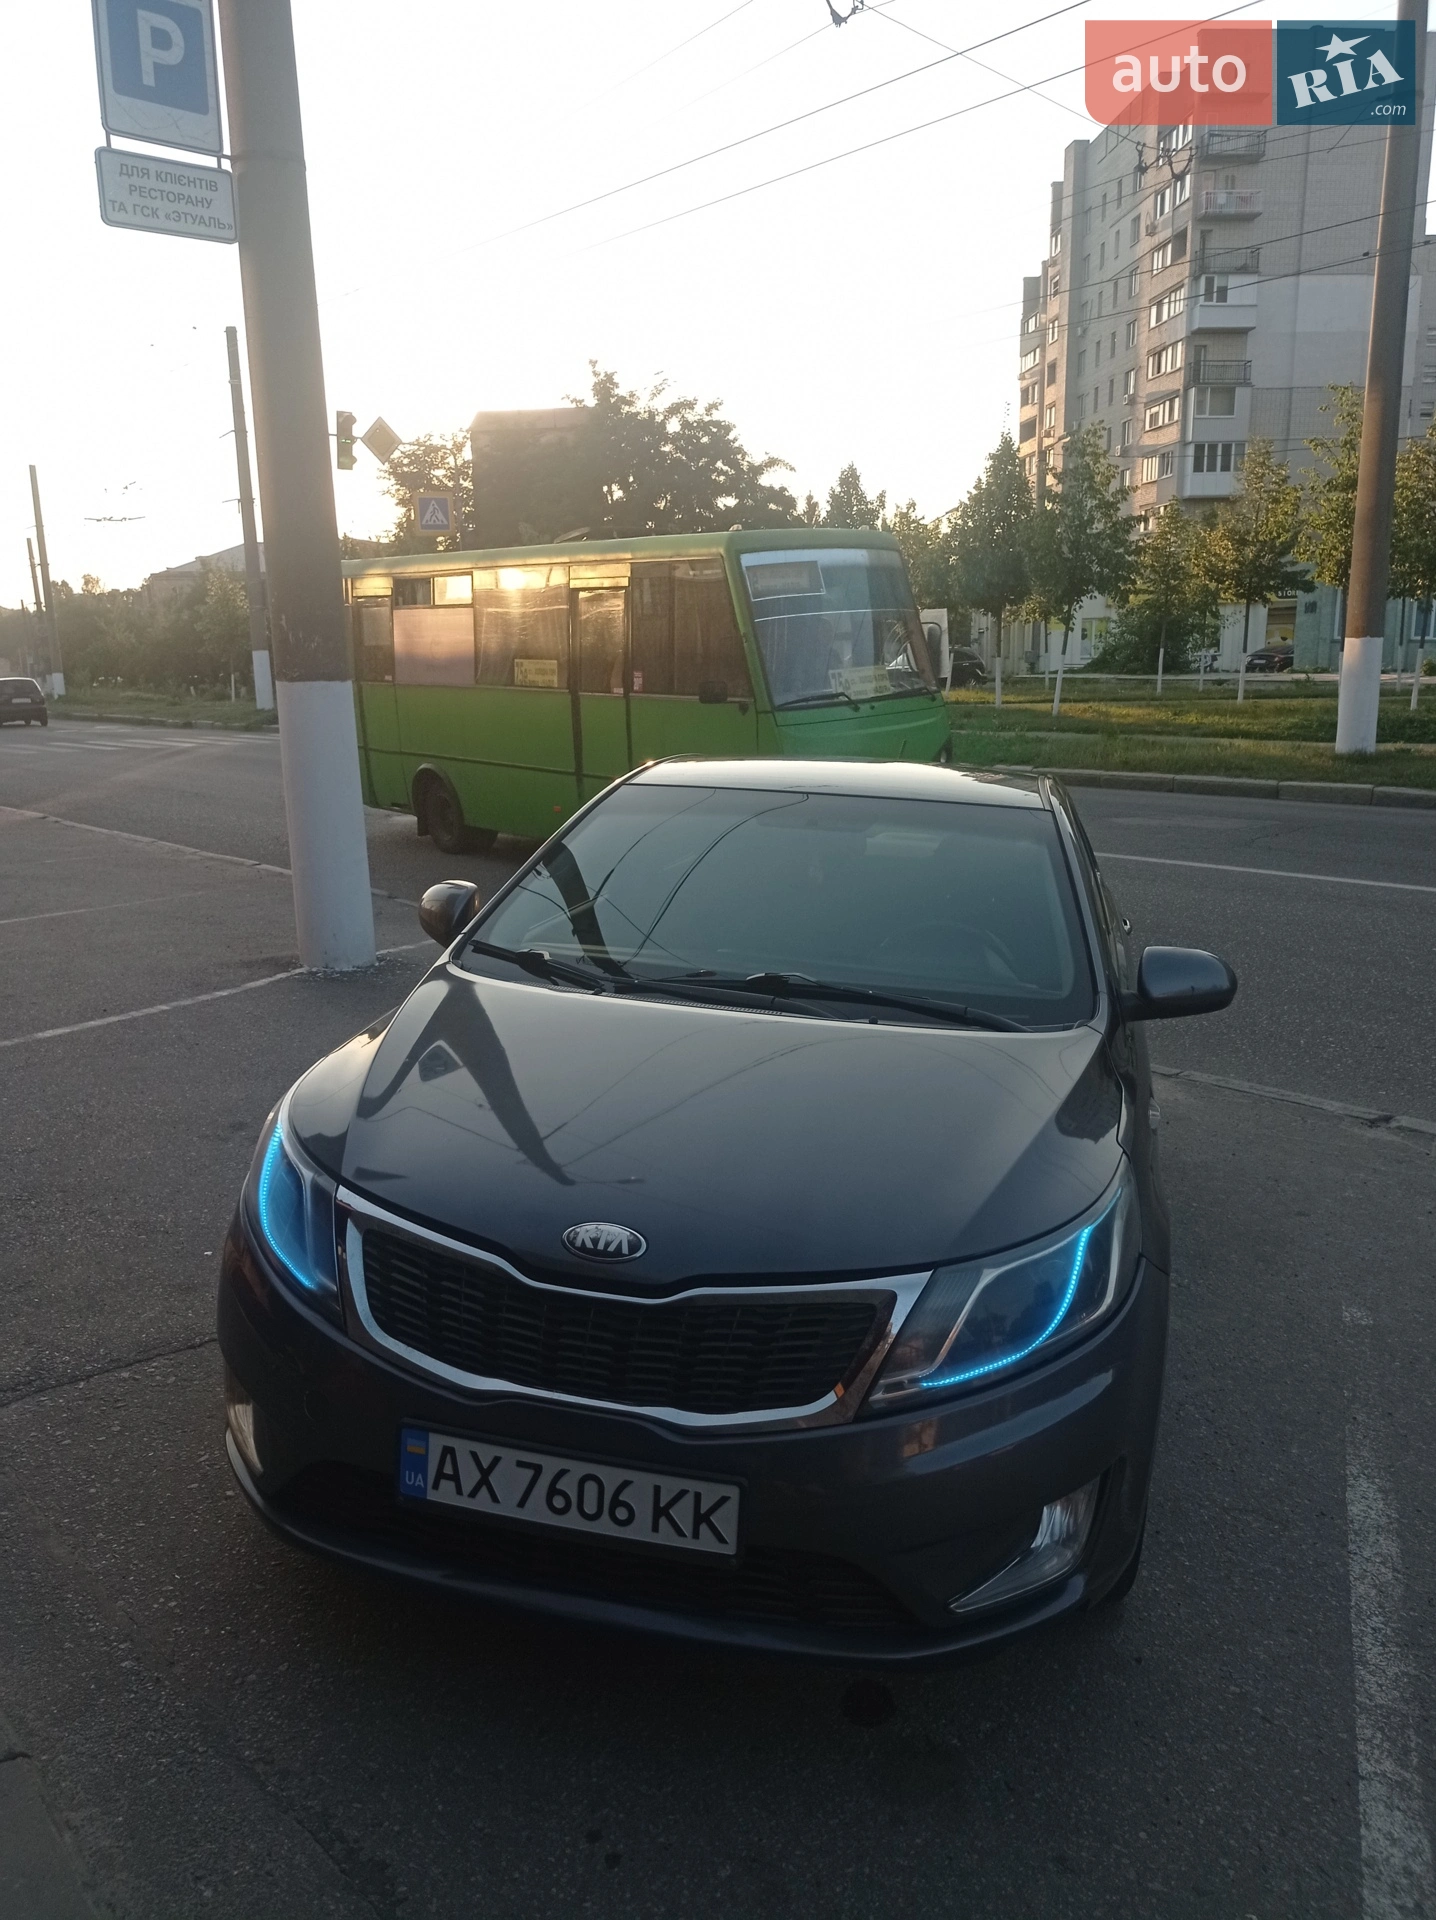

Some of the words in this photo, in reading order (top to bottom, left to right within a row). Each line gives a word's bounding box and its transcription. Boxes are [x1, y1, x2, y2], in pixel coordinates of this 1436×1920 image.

[137, 8, 185, 88] P
[119, 163, 150, 180] ДЛЯ
[155, 170, 219, 192] КЛІЄНТІВ
[128, 184, 213, 209] РЕСТОРАНУ
[109, 200, 128, 215] ТА
[132, 203, 160, 220] ГСК
[164, 210, 234, 231] «ЭТУАЛЬ»
[575, 1227, 629, 1255] KIA
[405, 1471, 425, 1489] UA
[431, 1445, 502, 1505] AX
[515, 1459, 636, 1527] 7606
[652, 1484, 732, 1545] KK
